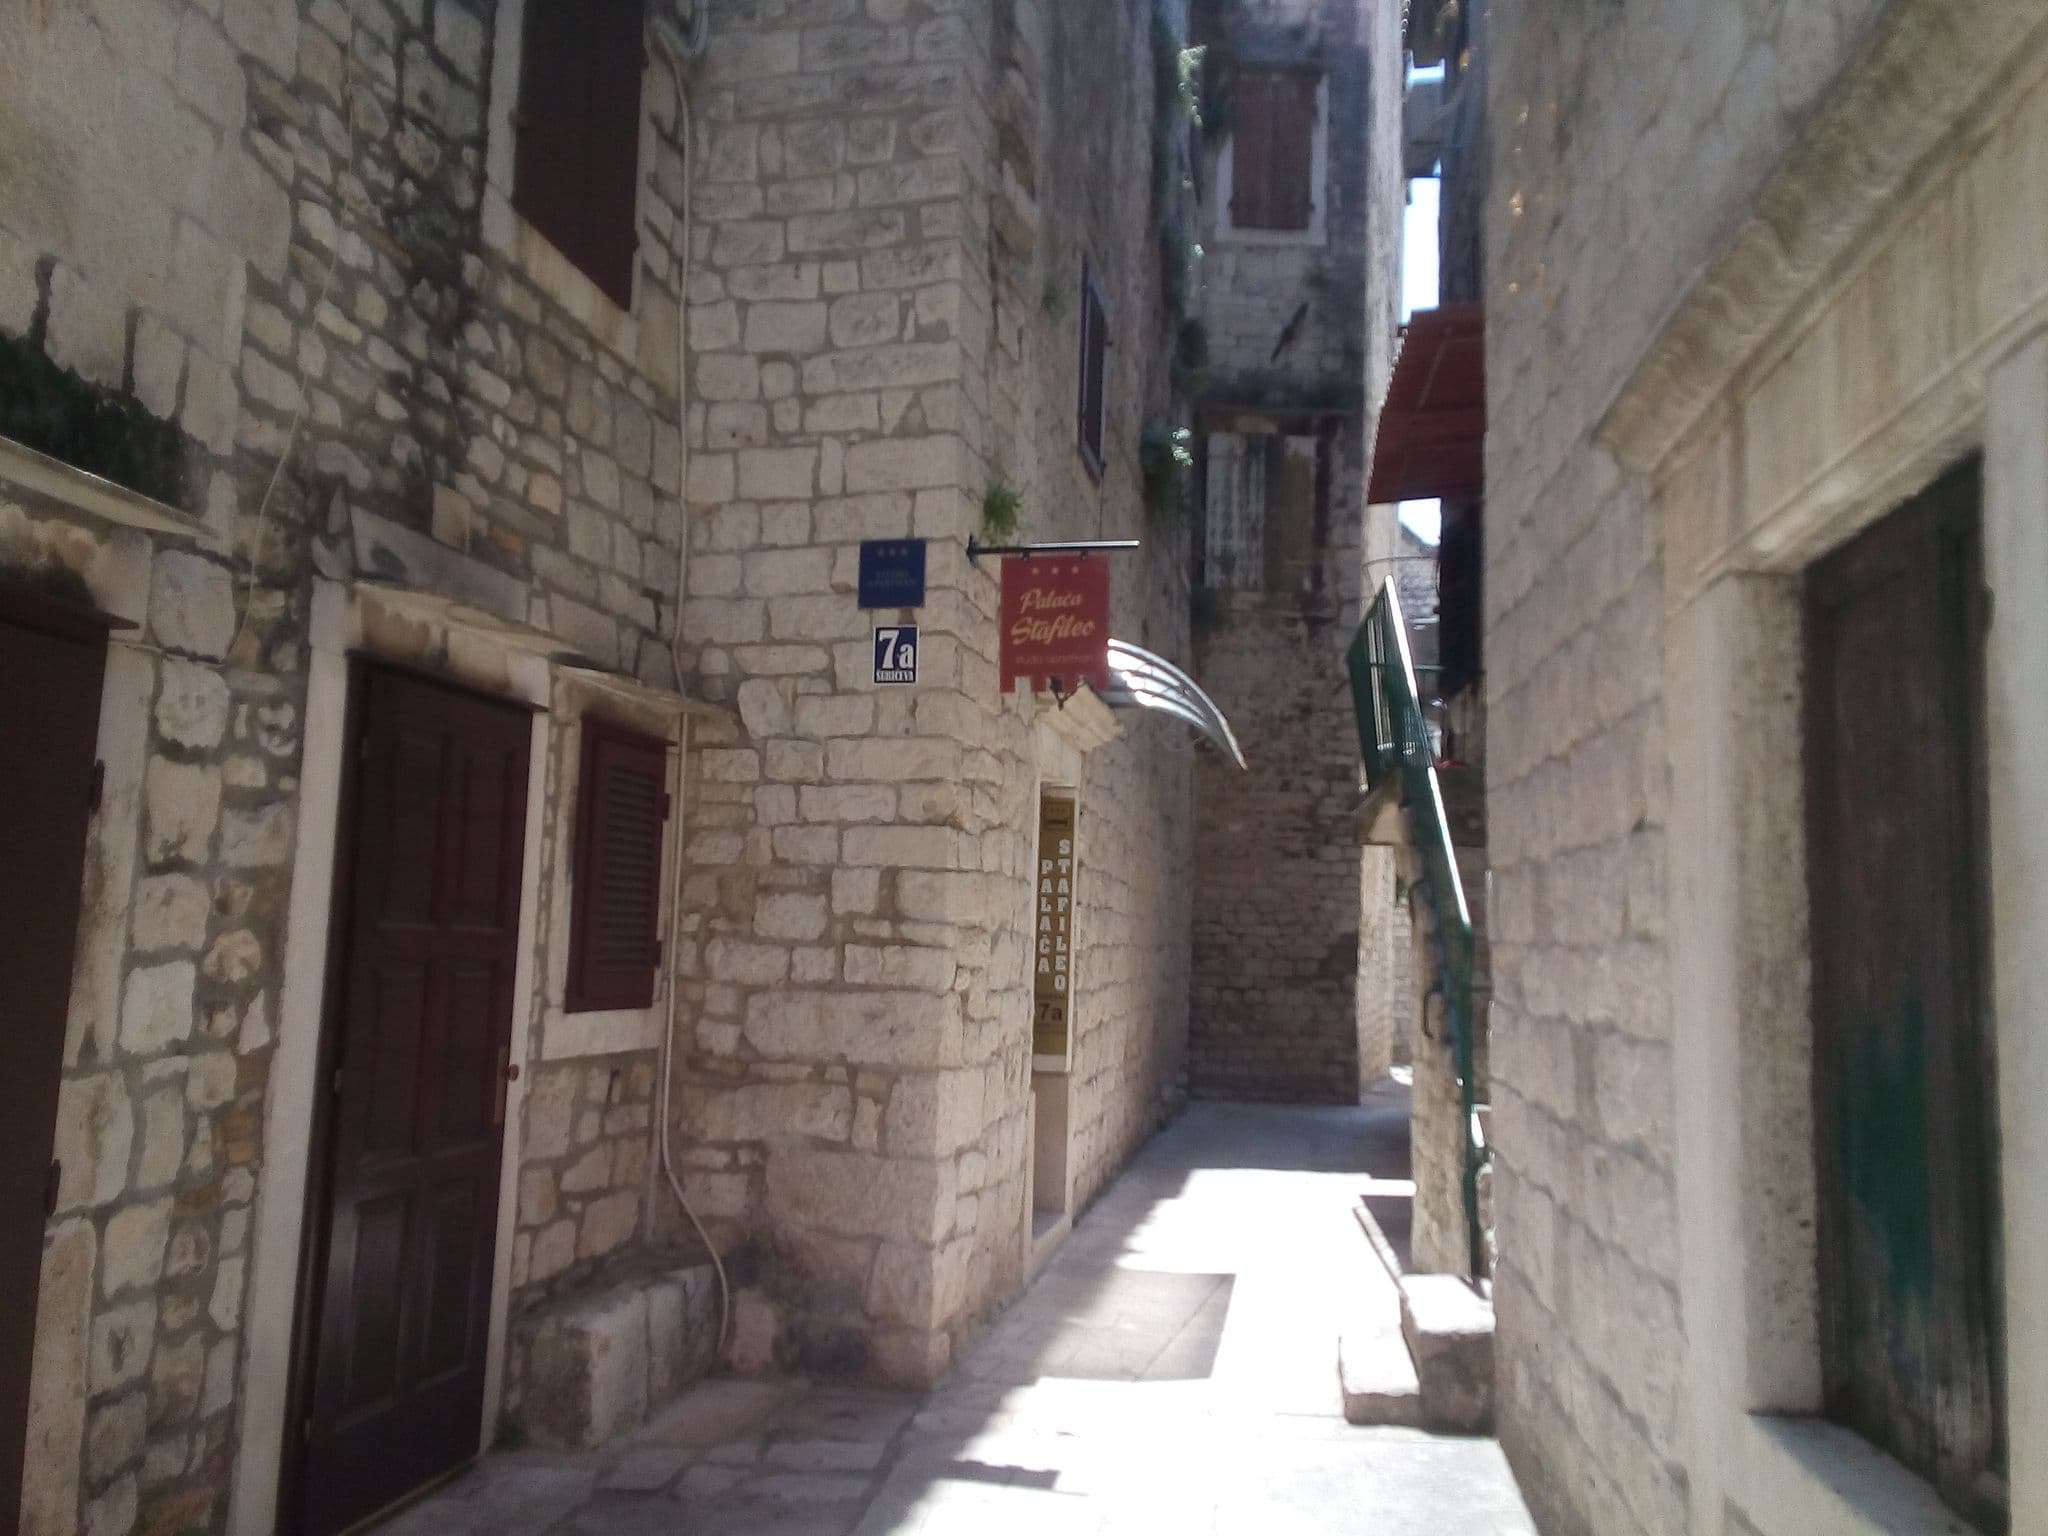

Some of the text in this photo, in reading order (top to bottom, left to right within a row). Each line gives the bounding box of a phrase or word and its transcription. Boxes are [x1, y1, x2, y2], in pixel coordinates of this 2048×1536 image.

[879, 629, 914, 669] 7a
[1054, 838, 1071, 991] STAFILEO
[1040, 1003, 1062, 1021] 7a
